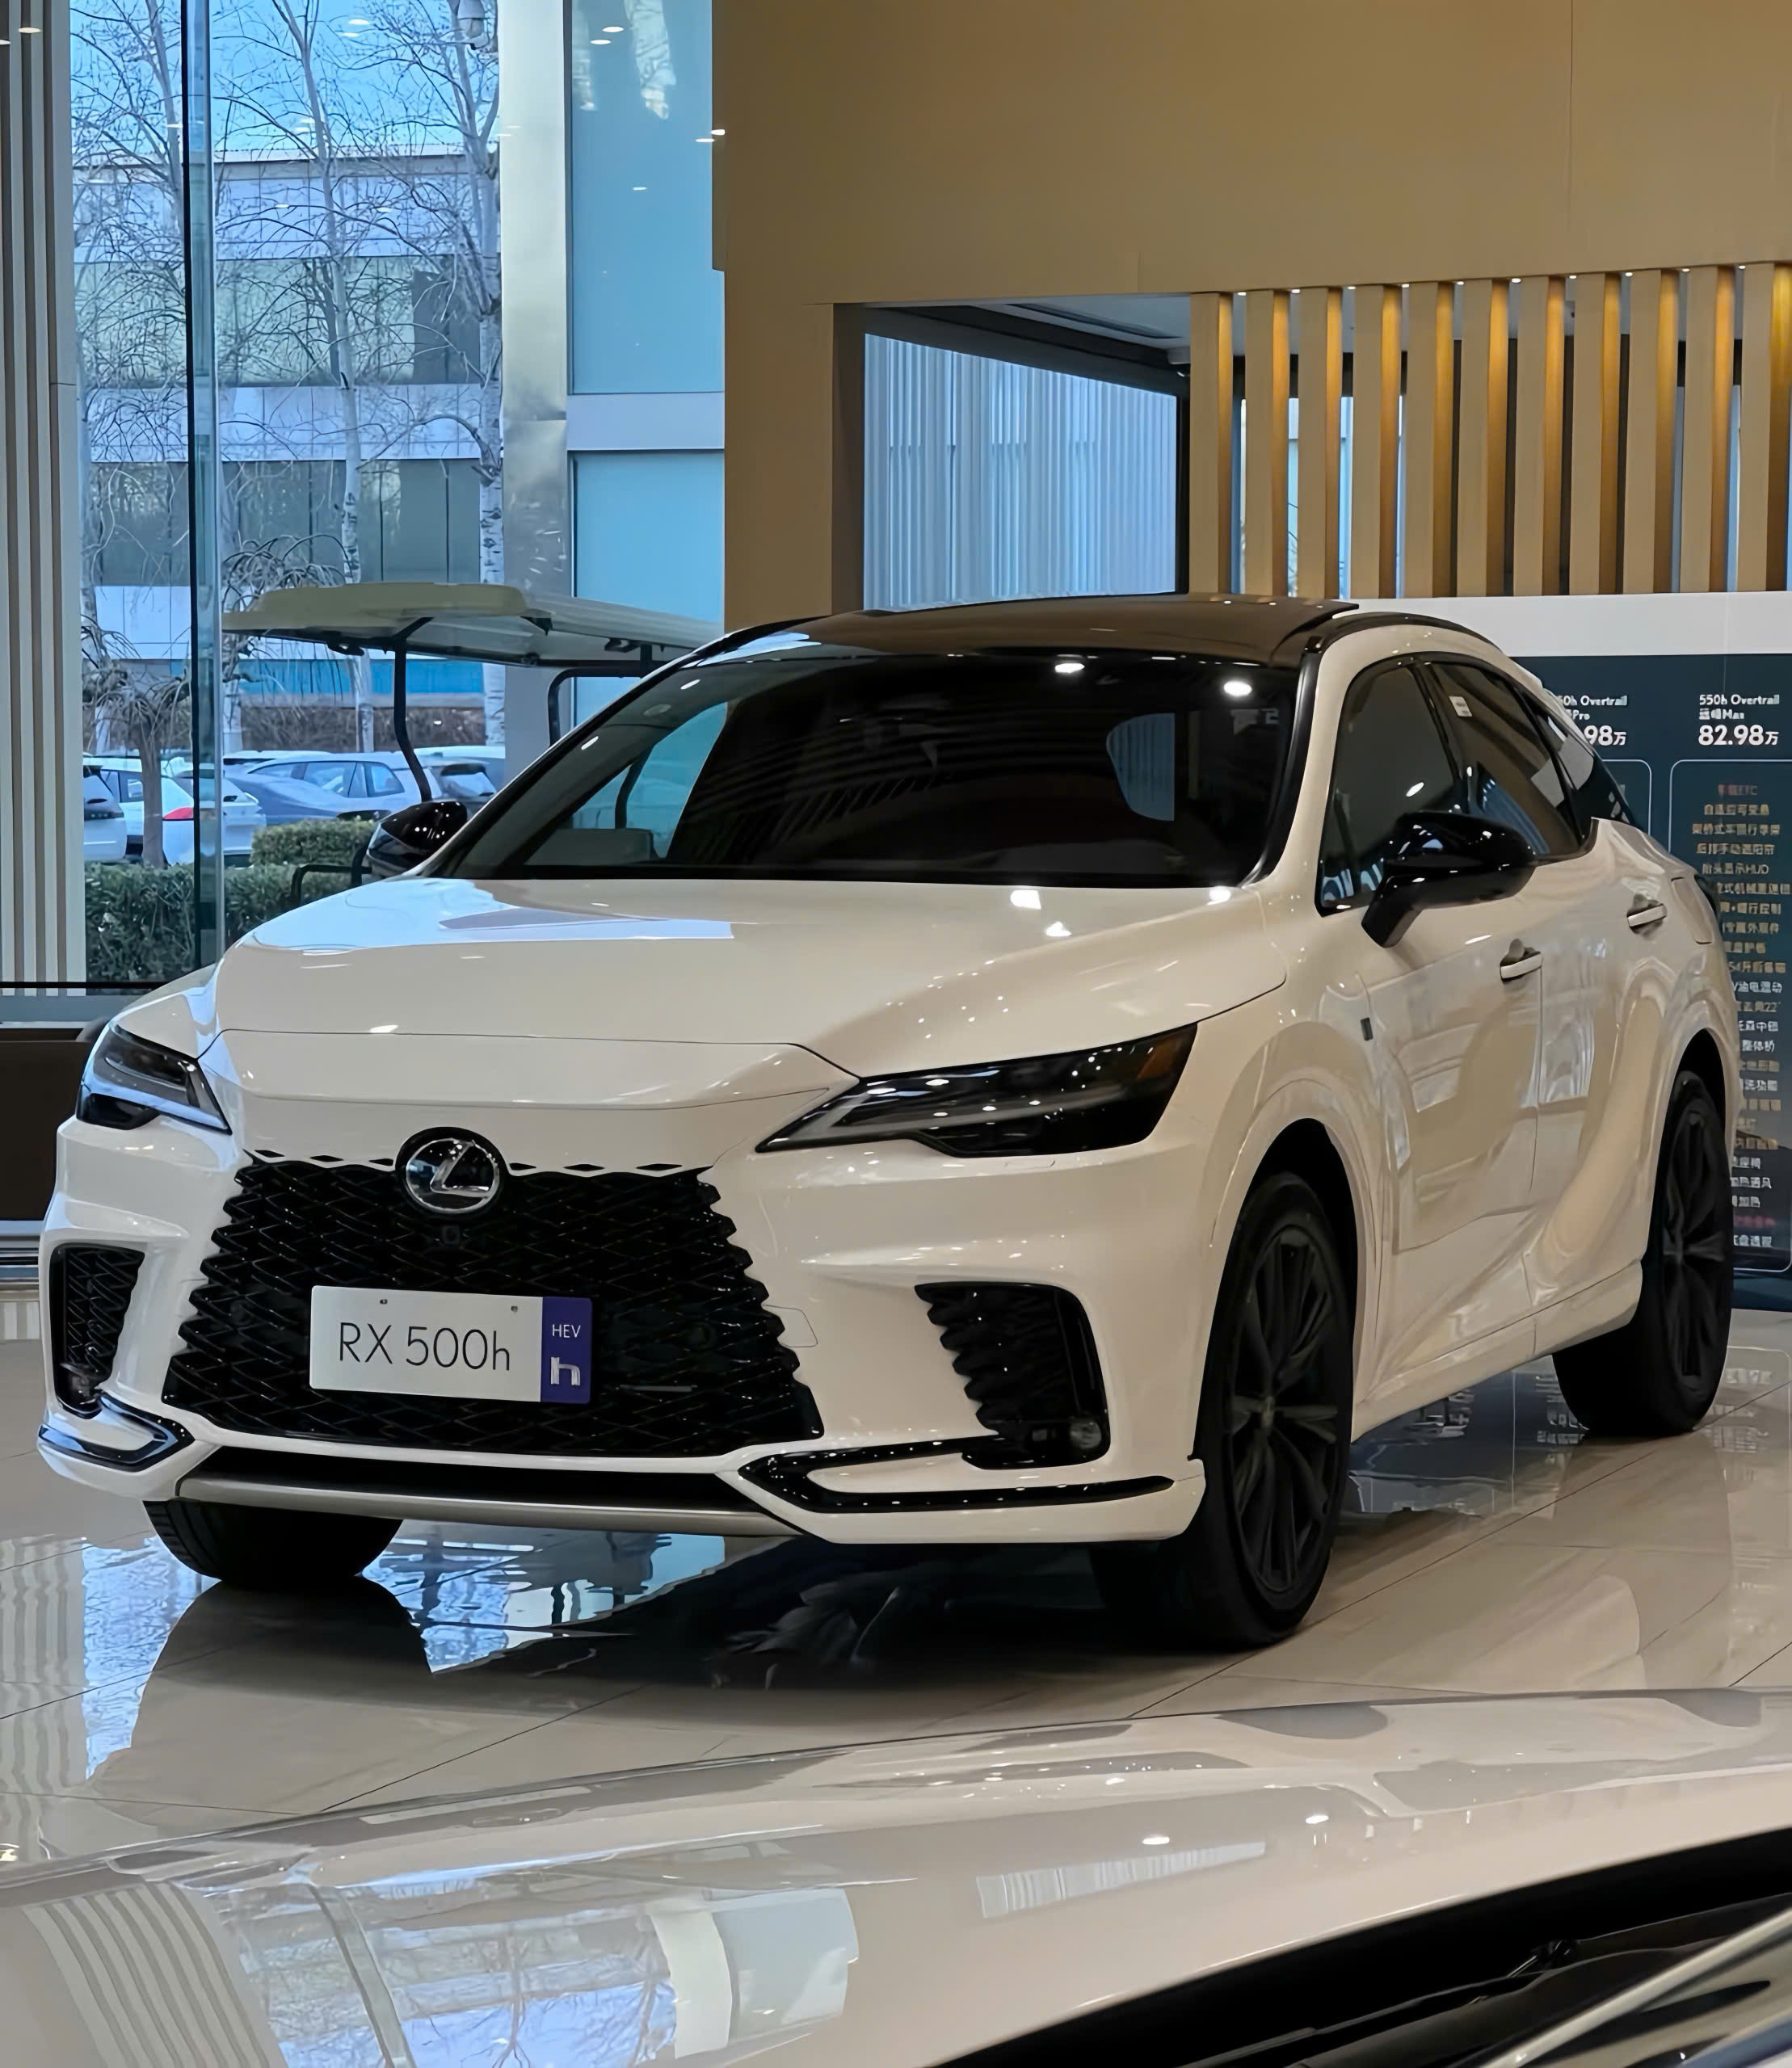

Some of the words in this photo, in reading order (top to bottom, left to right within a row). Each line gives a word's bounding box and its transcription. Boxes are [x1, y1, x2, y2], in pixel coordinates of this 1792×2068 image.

[1580, 695, 1627, 706] Overtrail
[1699, 694, 1728, 705] 550h
[1731, 694, 1780, 705] Overtrail
[1697, 724, 1779, 746] 82.98万
[552, 1324, 582, 1339] HEV
[339, 1322, 393, 1364] RX
[405, 1325, 511, 1371] 500h
[549, 1356, 581, 1386] h
